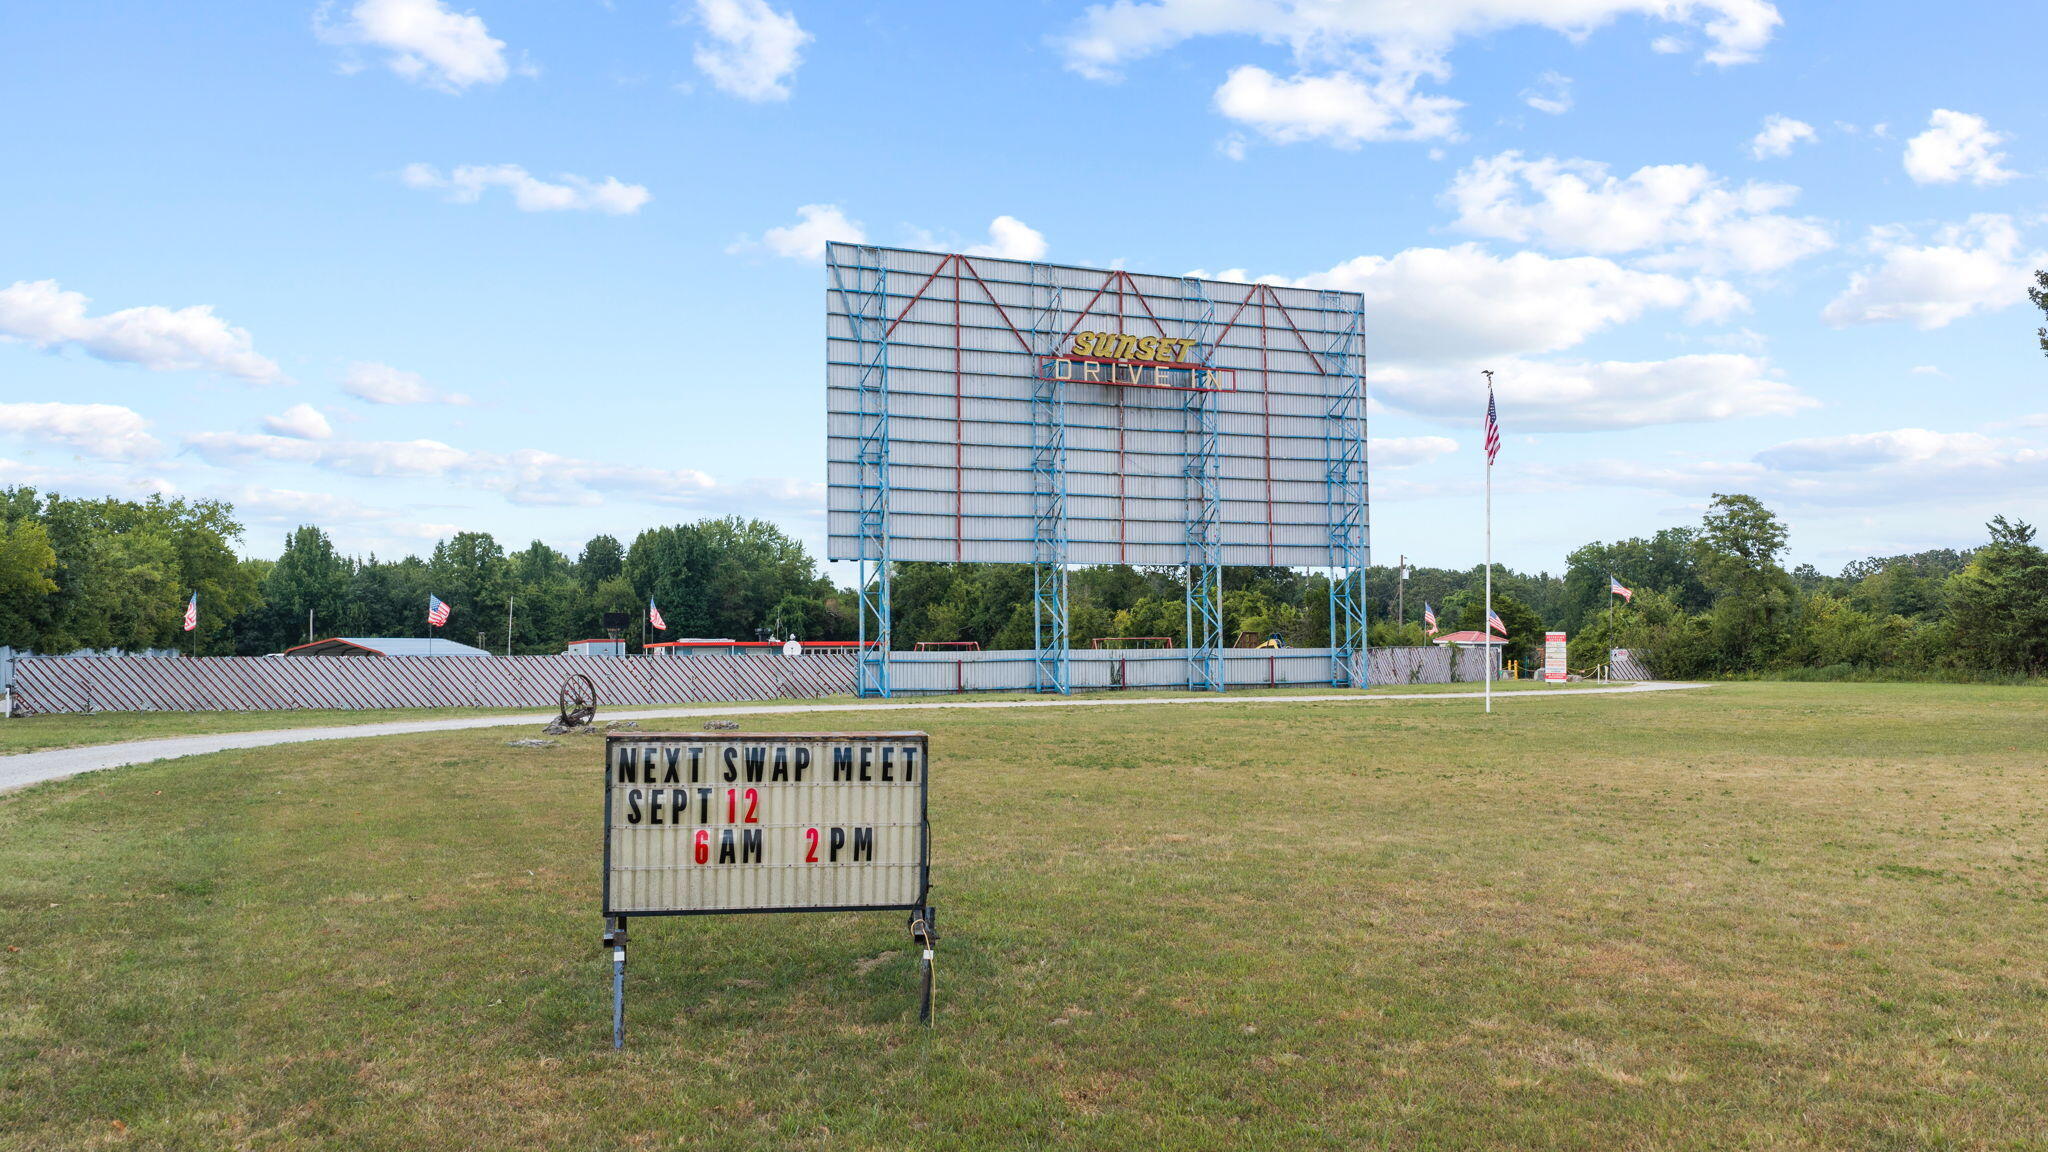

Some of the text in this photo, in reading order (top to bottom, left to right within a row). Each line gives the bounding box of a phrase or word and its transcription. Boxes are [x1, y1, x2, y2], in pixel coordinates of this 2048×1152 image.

[1071, 331, 1196, 363] SUNSET
[1055, 359, 1222, 390] DRIVE IN
[618, 747, 917, 783] NEXT SWAP MEET
[627, 787, 758, 825] SEPT 12
